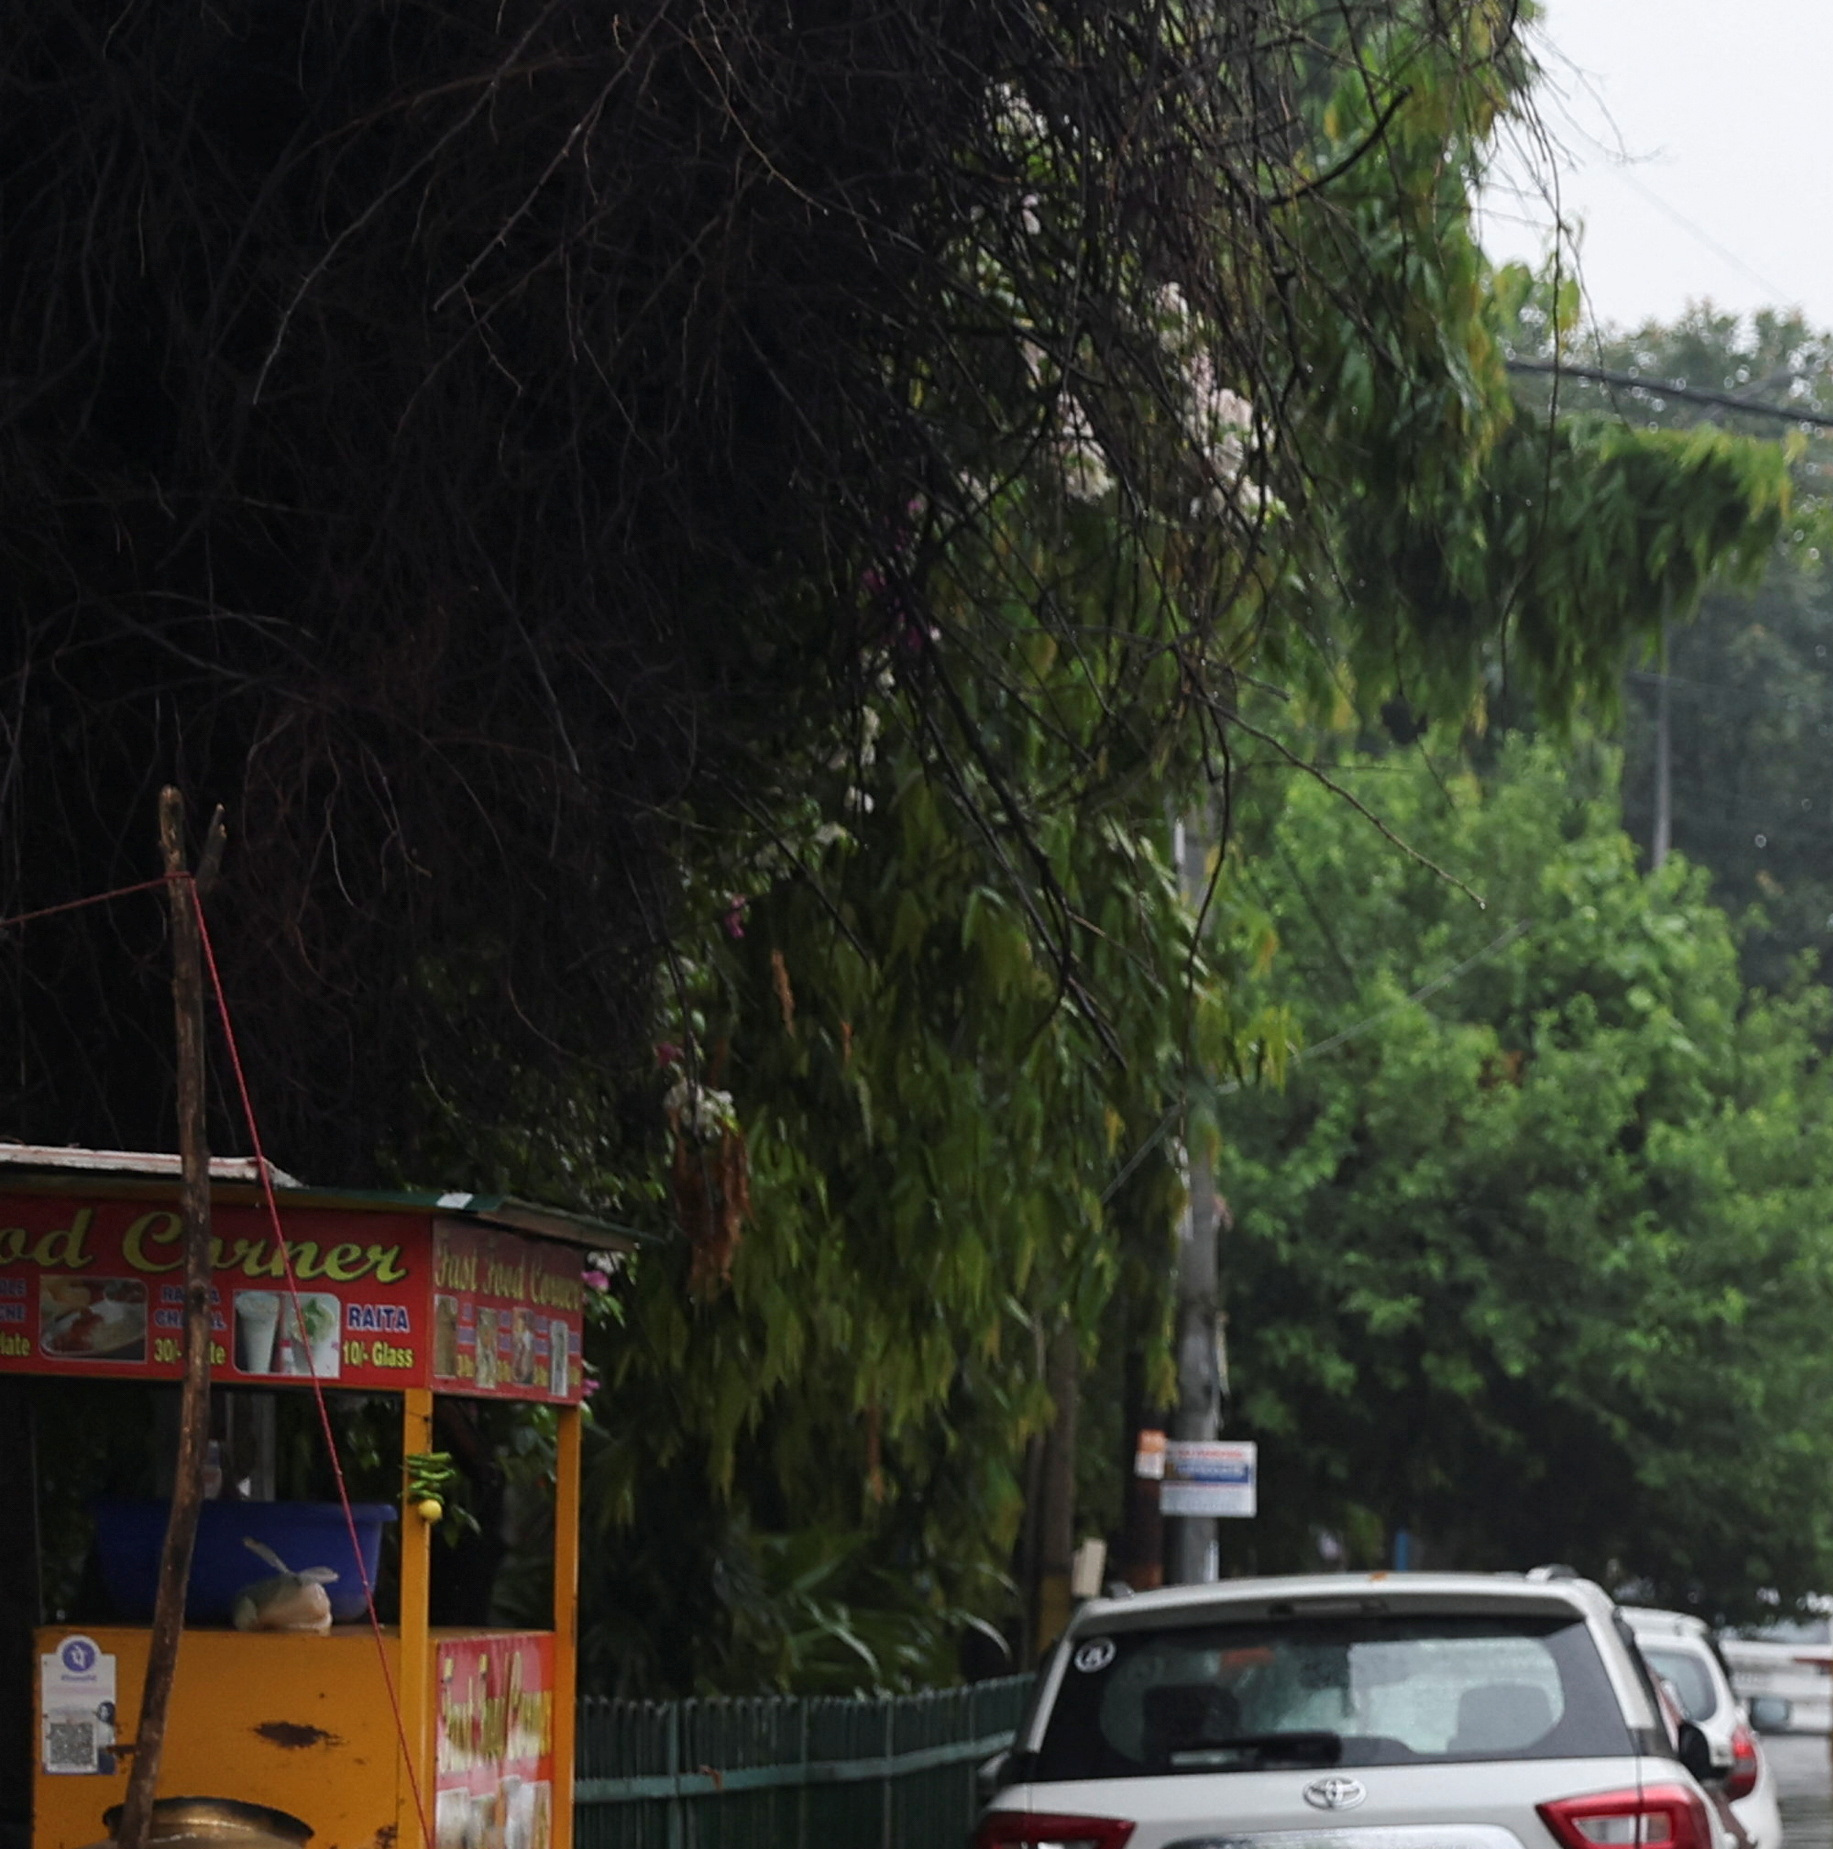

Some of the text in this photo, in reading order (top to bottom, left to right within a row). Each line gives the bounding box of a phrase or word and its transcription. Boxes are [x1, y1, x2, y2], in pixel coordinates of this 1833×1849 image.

[162, 1286, 221, 1304] RAA
[347, 1305, 409, 1332] RAITA
[343, 1340, 414, 1368] 10/- Glass
